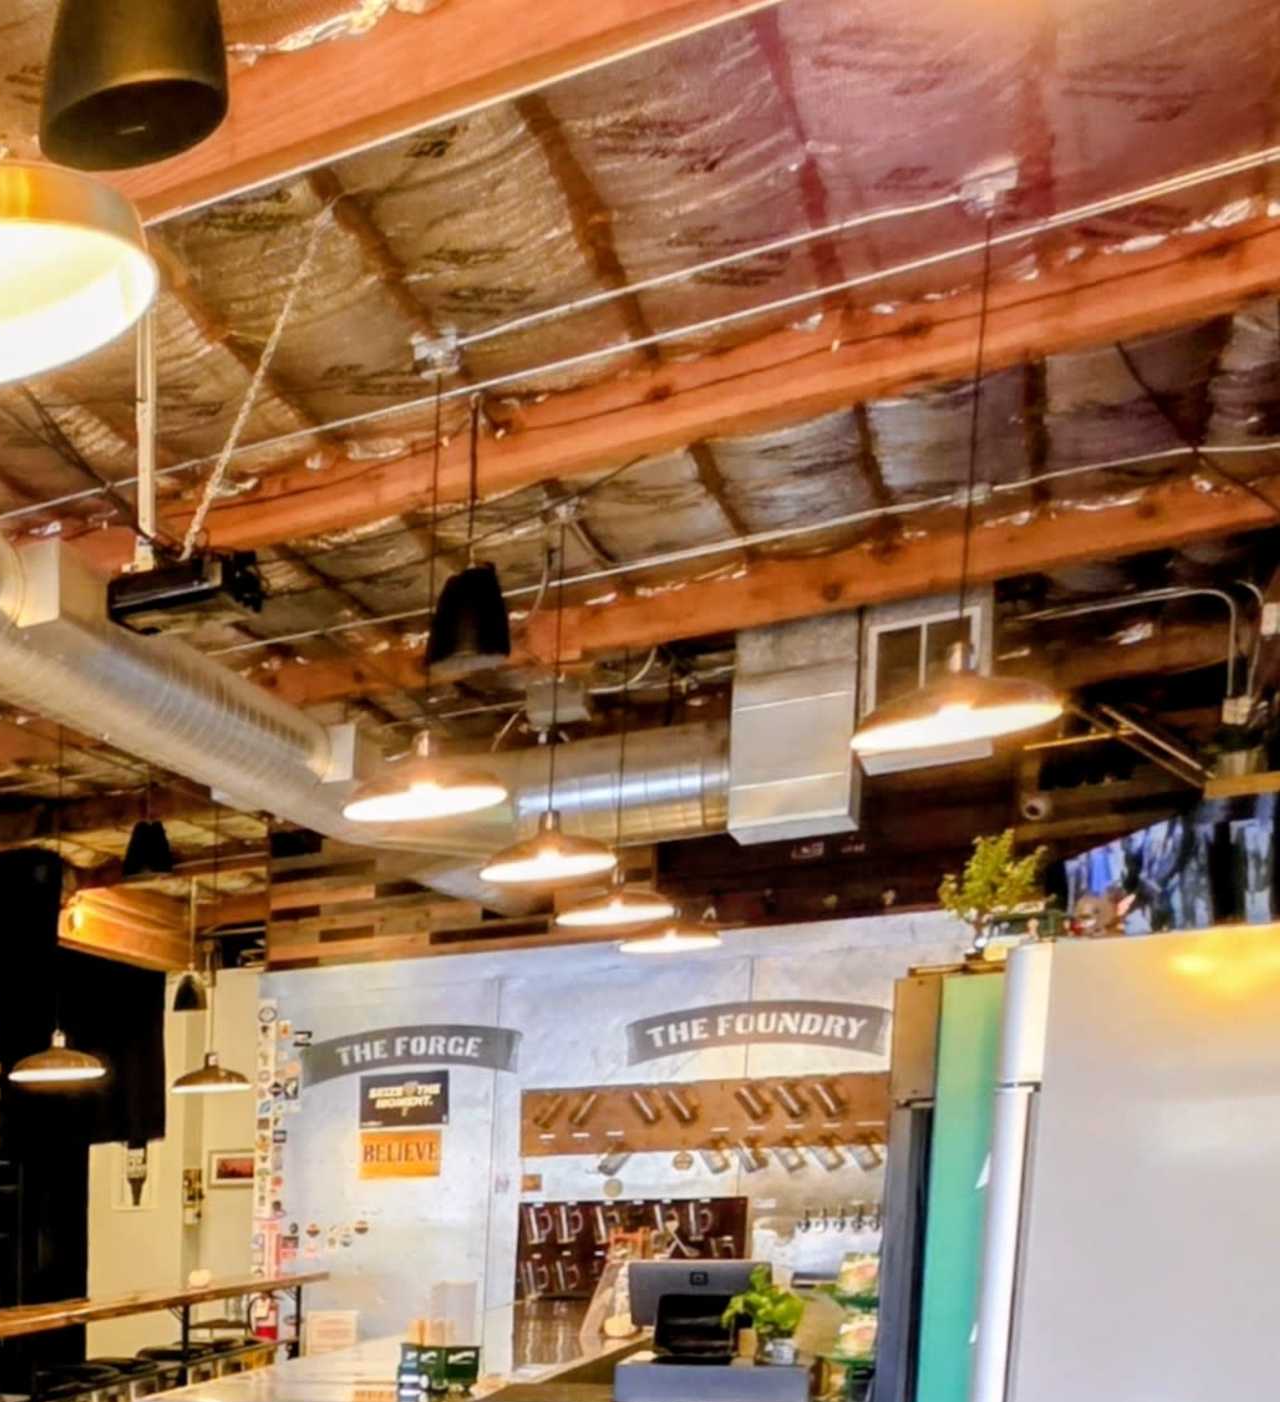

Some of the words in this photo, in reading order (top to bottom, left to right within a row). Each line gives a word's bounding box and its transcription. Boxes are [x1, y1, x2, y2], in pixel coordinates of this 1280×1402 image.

[645, 1018, 709, 1048] THE
[716, 1011, 868, 1040] FOUNDRY
[336, 1039, 388, 1067] THE
[394, 1035, 483, 1058] FORGE
[363, 1141, 439, 1164] BELIEVE
